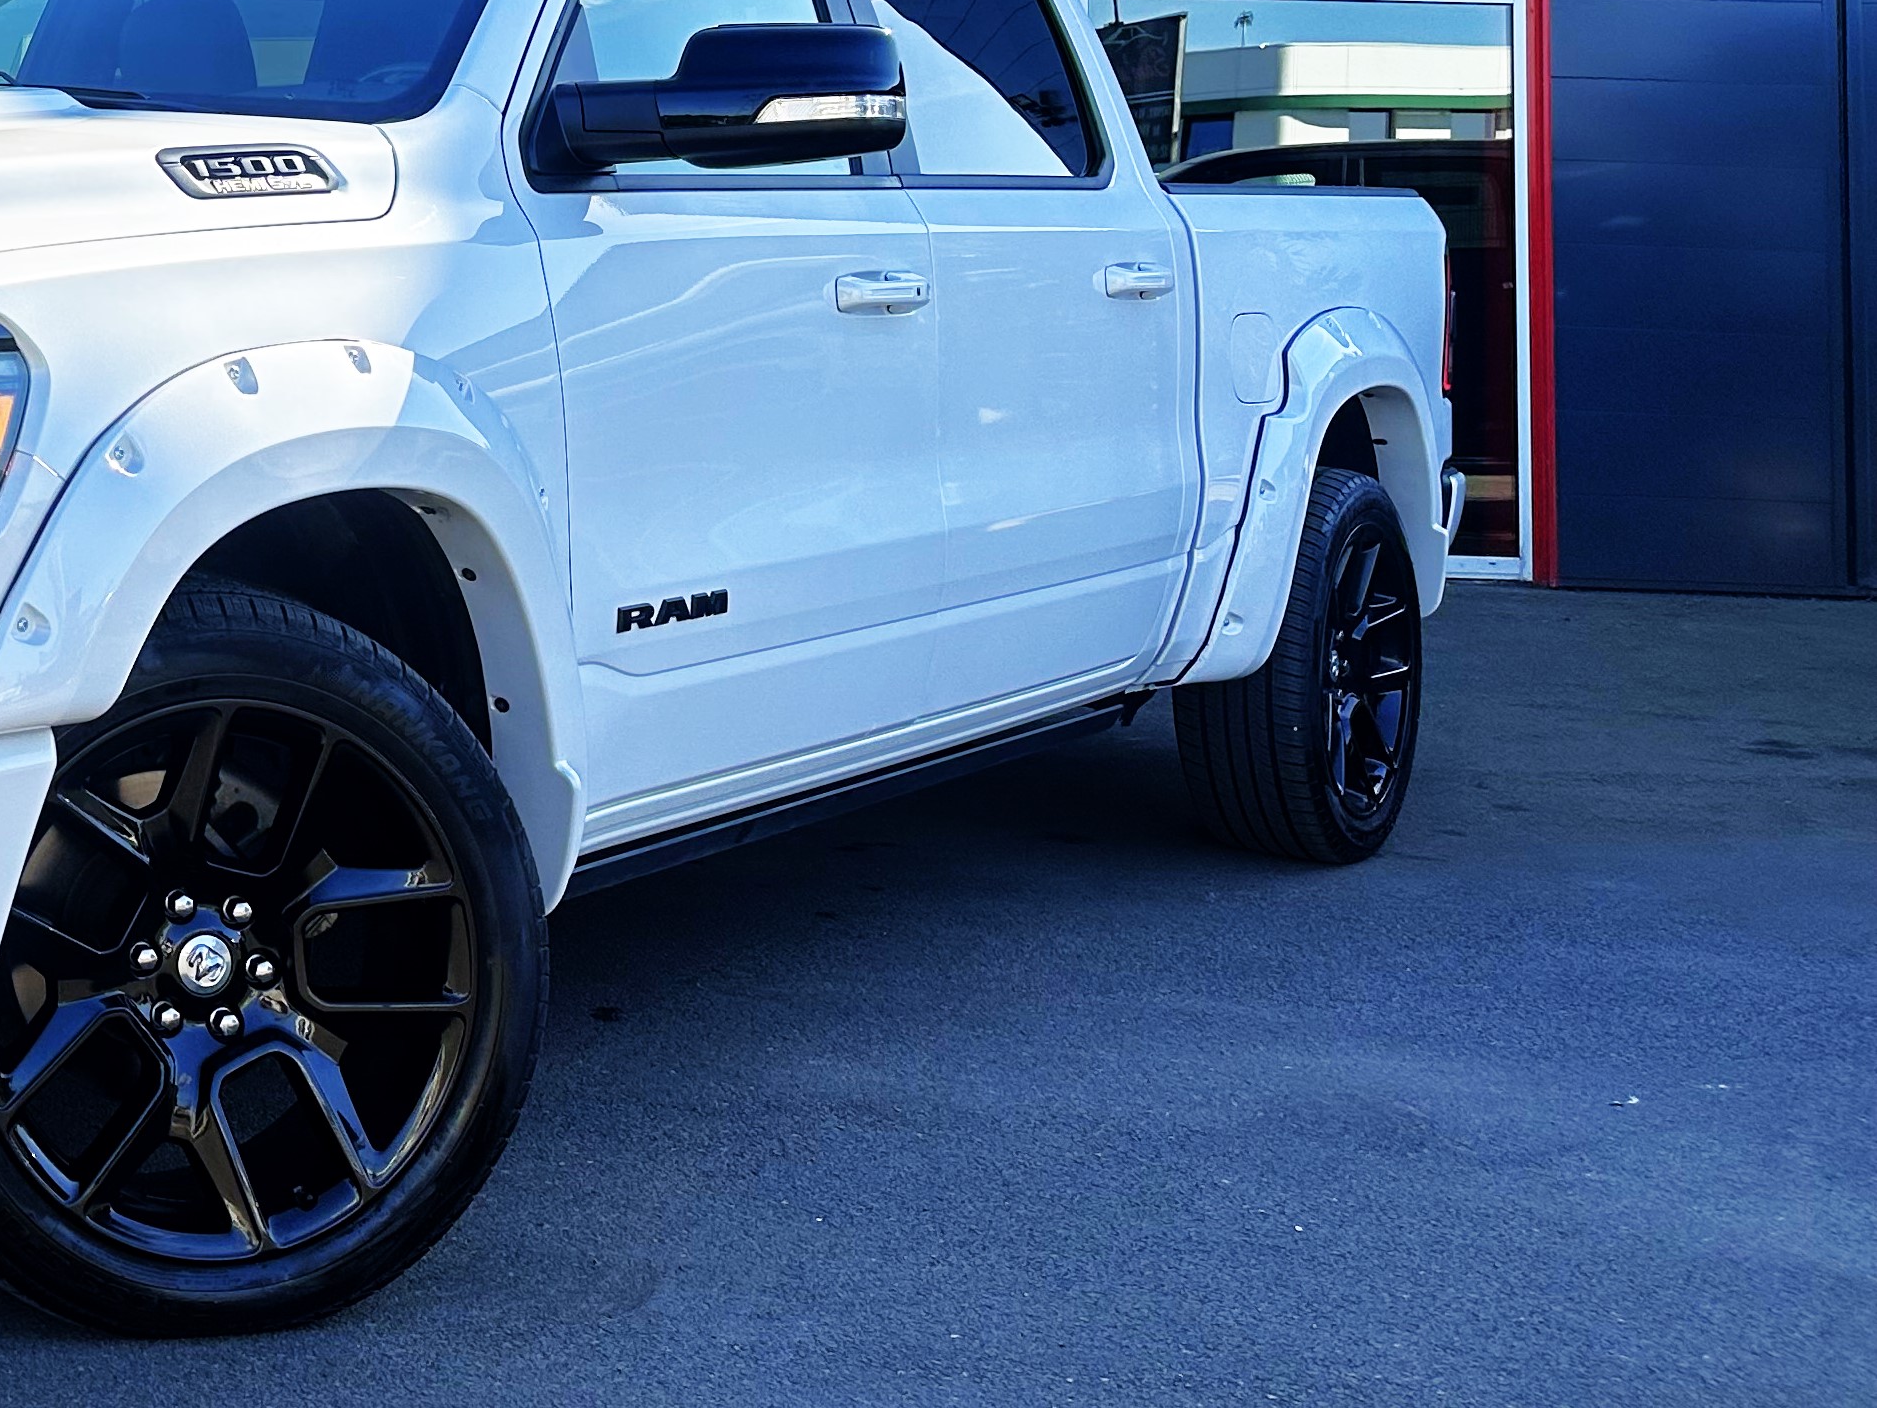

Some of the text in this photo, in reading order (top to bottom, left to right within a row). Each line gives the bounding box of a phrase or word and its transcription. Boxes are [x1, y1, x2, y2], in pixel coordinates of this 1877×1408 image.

[189, 155, 307, 177] 1500
[213, 178, 269, 194] HEMI
[616, 589, 729, 634] RAM
